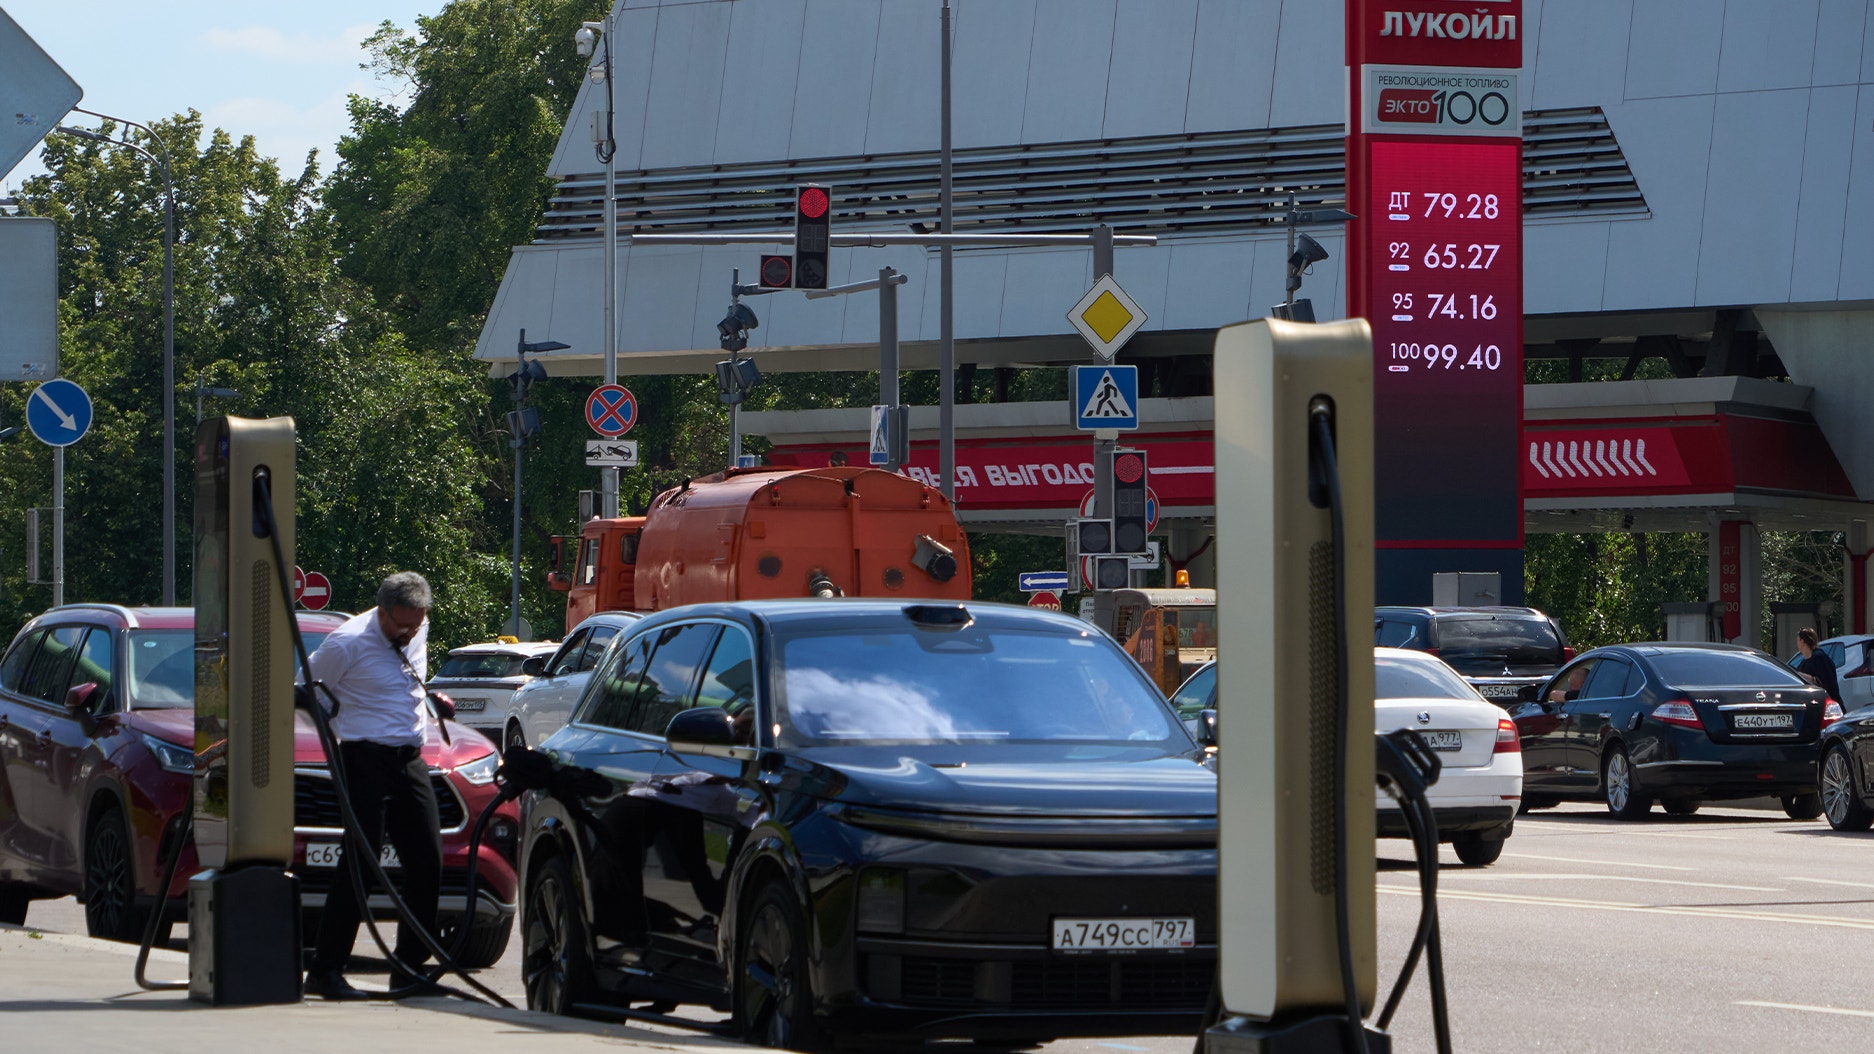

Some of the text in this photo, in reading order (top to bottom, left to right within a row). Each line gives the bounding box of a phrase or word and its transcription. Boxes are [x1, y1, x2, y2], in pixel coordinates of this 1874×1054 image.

[1380, 8, 1516, 40] ЛУКОЙЛ
[1378, 75, 1510, 89] РЕВОЛЮЦИОННОЕ ТОПЛИВО
[1385, 90, 1509, 126] ЭКТО 100
[1388, 191, 1499, 220] ДТ 79.28
[1388, 242, 1501, 270] 92 65.27
[1392, 292, 1497, 321] 95 74.16
[1390, 343, 1501, 371] 100 99.40
[984, 463, 1094, 486] ВЫГОДО
[1722, 564, 1736, 575] 92
[1722, 583, 1736, 593] 95
[1726, 602, 1739, 612] 00
[1737, 715, 1790, 727] Е440УТ 197
[1438, 732, 1457, 742] 977
[1061, 921, 1188, 947] А749СС 797
